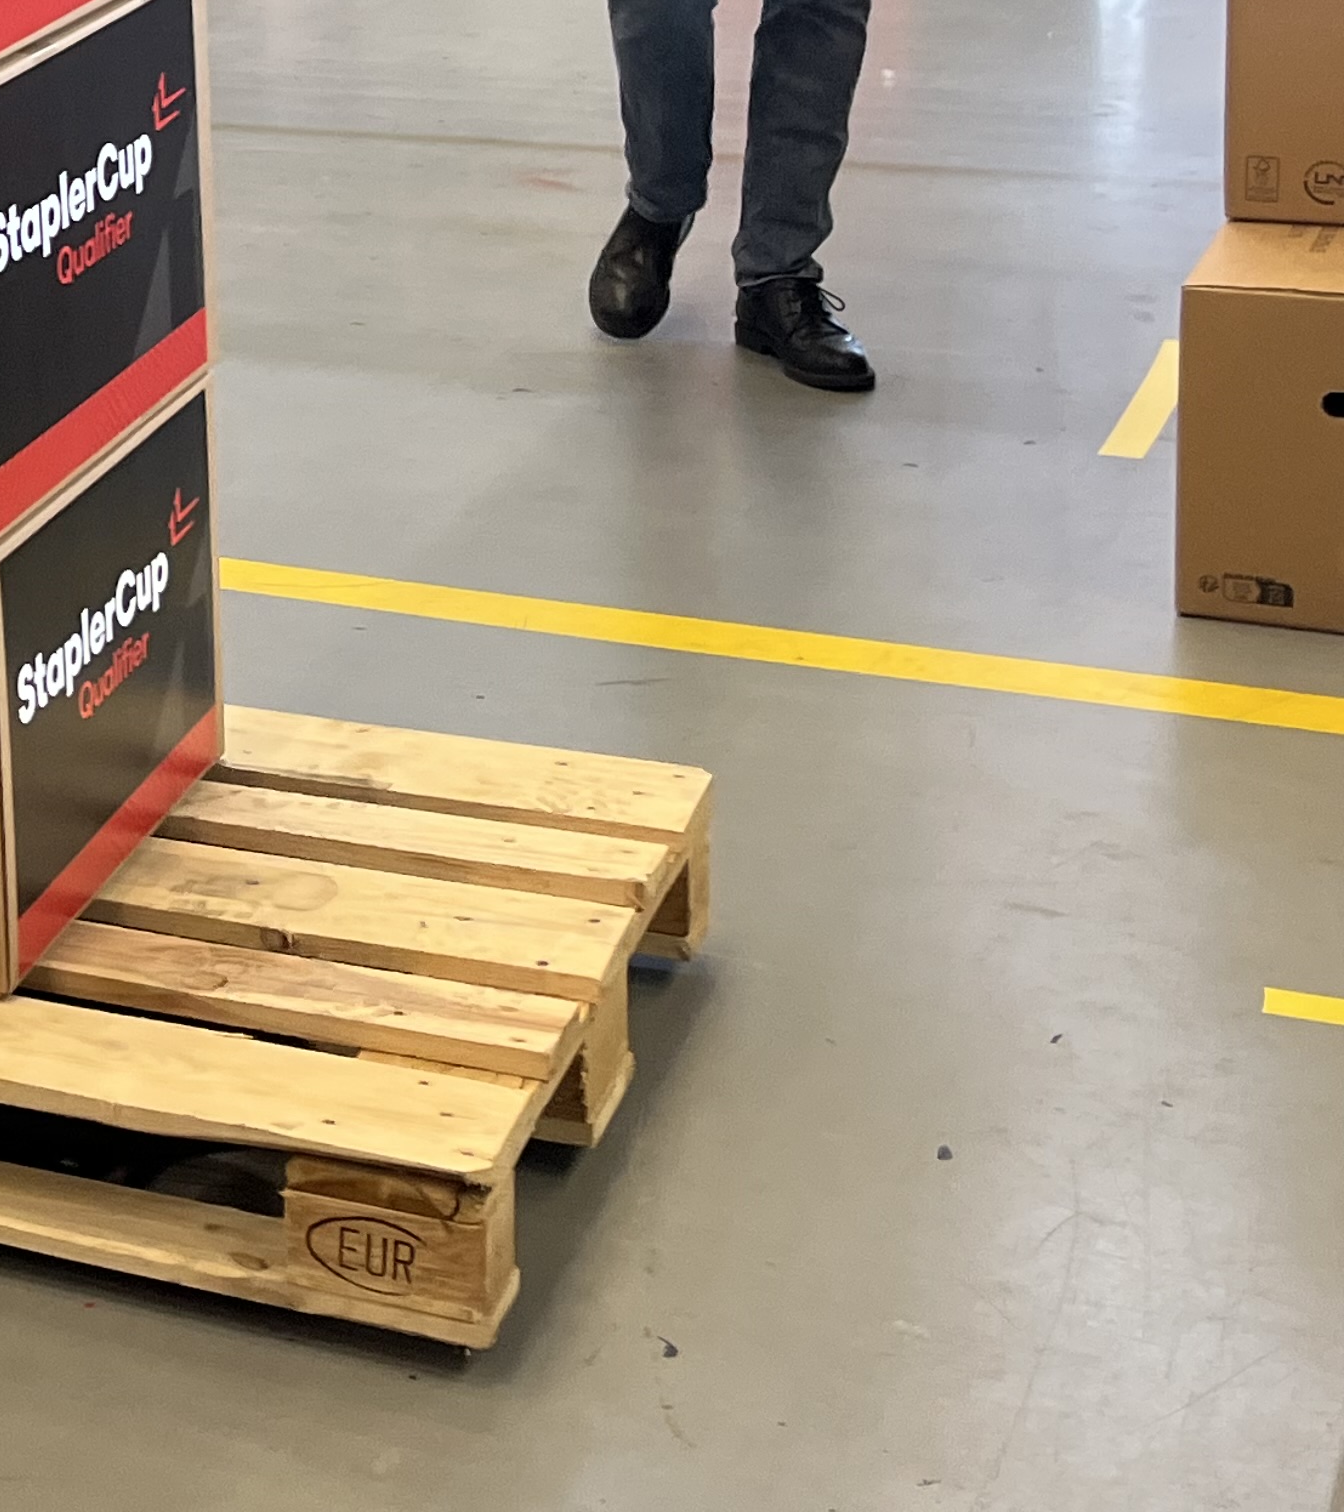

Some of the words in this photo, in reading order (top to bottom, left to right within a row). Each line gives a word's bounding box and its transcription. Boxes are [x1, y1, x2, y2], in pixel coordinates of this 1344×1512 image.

[57, 211, 133, 284] Qualifier
[17, 552, 169, 724] StaplerCup
[78, 632, 150, 719] Qualifier
[338, 1226, 416, 1284] EUR
